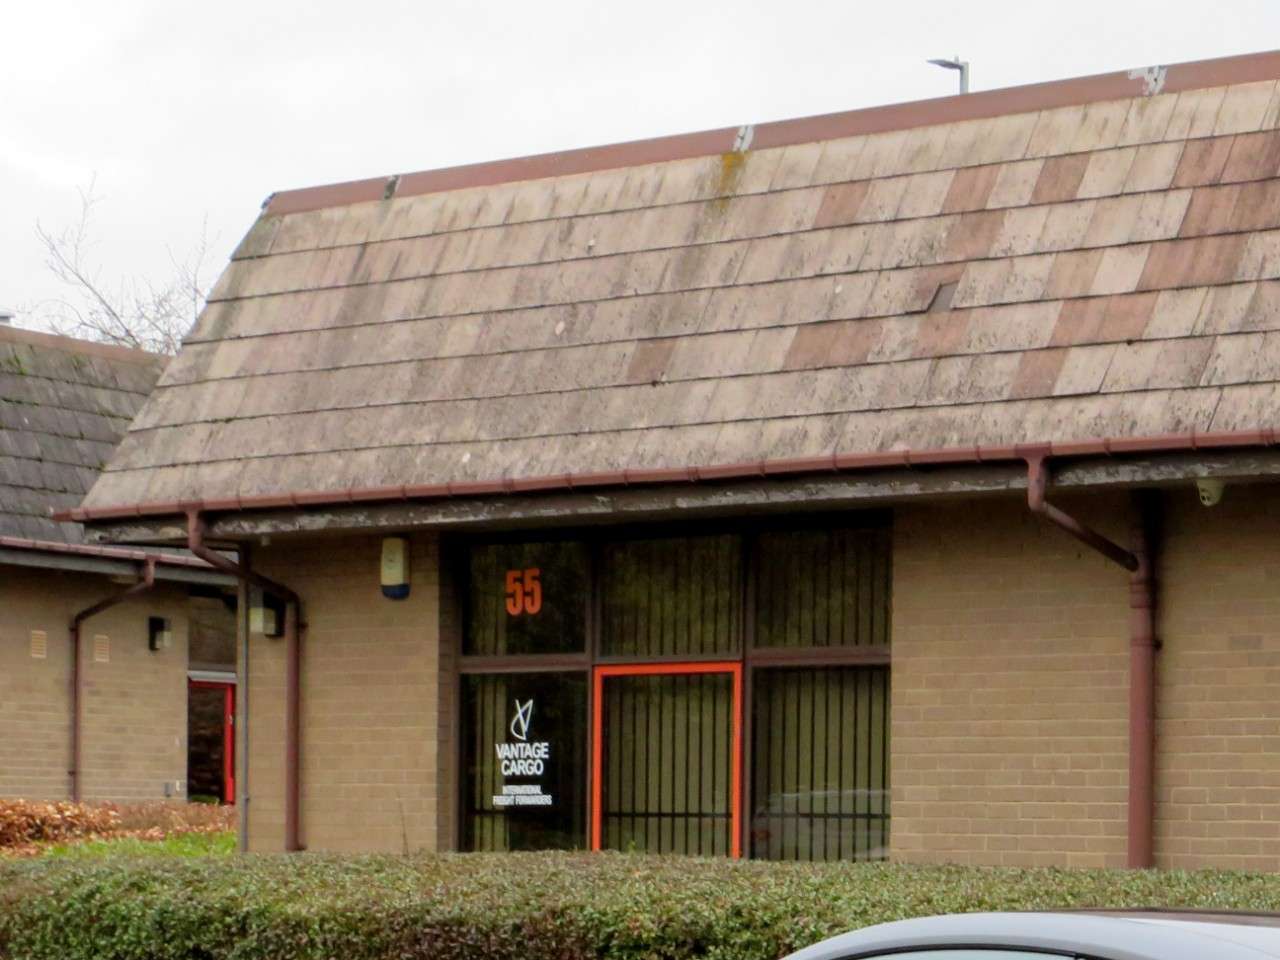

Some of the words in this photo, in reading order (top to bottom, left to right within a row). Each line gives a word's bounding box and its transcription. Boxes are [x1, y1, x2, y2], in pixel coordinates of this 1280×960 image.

[505, 568, 542, 616] 55
[495, 742, 549, 759] VANTAGE
[501, 759, 544, 776] CARGO
